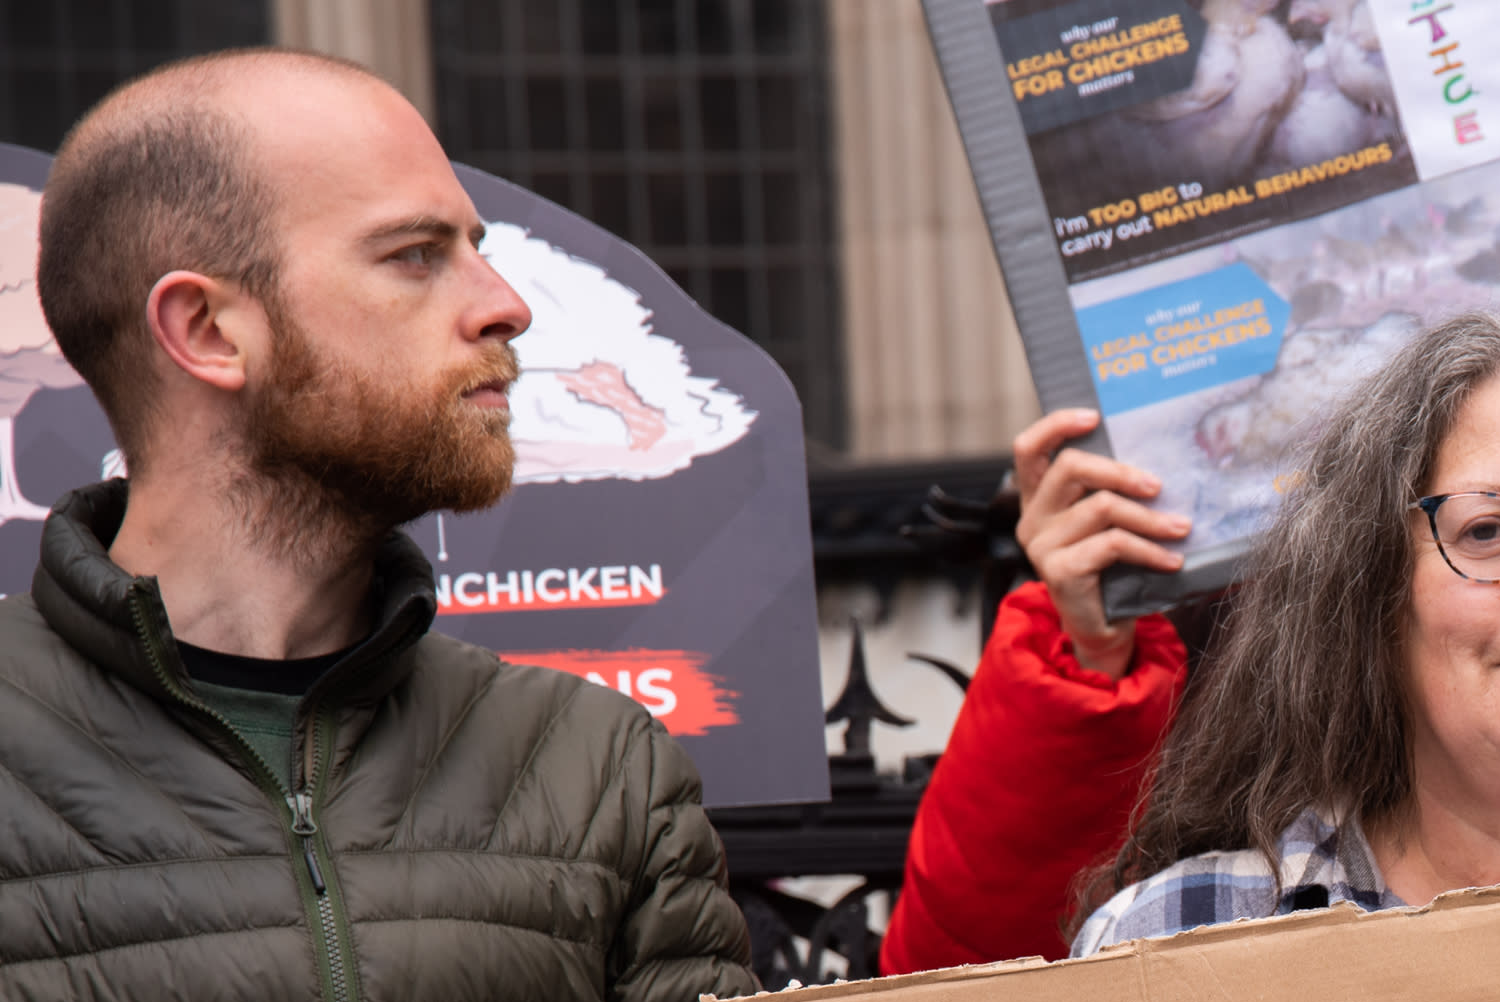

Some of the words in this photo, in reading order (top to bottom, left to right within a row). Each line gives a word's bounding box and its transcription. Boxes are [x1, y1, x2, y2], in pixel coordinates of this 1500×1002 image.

[1007, 48, 1069, 79] LEGAL
[1070, 13, 1184, 61] CHALLENGE
[1013, 69, 1065, 101] FOR
[1067, 32, 1190, 85] CHICKENS
[1062, 226, 1113, 256] carry
[1116, 216, 1153, 241] out
[1153, 186, 1254, 229] NATURAL
[1255, 142, 1393, 199] BEHAVIOURS
[1088, 199, 1137, 226] TOO
[1139, 186, 1179, 213] BIG
[1178, 182, 1203, 200] to
[1092, 332, 1152, 360] LEGAL
[1154, 298, 1265, 342] CHALLENGE
[1098, 352, 1147, 381] FOR
[1152, 316, 1272, 365] CHICKENS
